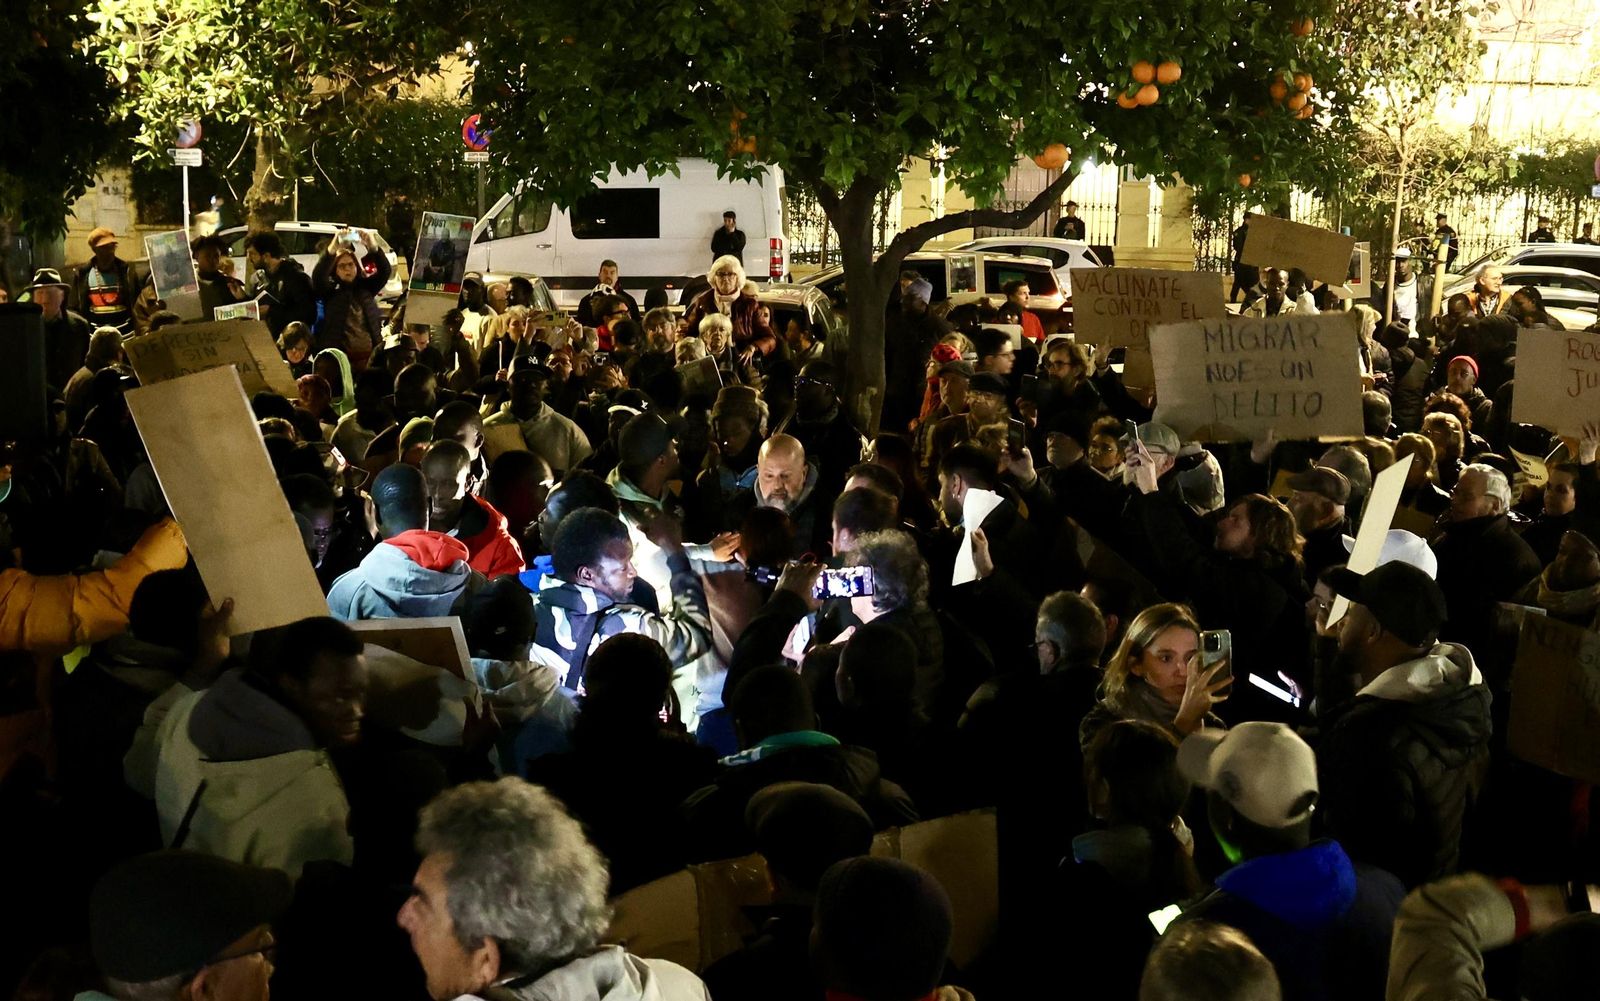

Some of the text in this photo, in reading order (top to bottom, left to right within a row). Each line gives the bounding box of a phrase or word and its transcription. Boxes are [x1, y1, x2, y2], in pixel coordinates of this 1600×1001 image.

[1071, 270, 1183, 302] VACUNATE
[1094, 295, 1205, 321] CONTRA EL
[1203, 321, 1322, 353] MIGRAR
[183, 345, 219, 362] SIN
[1280, 359, 1315, 381] UN
[1211, 388, 1323, 422] DELITO
